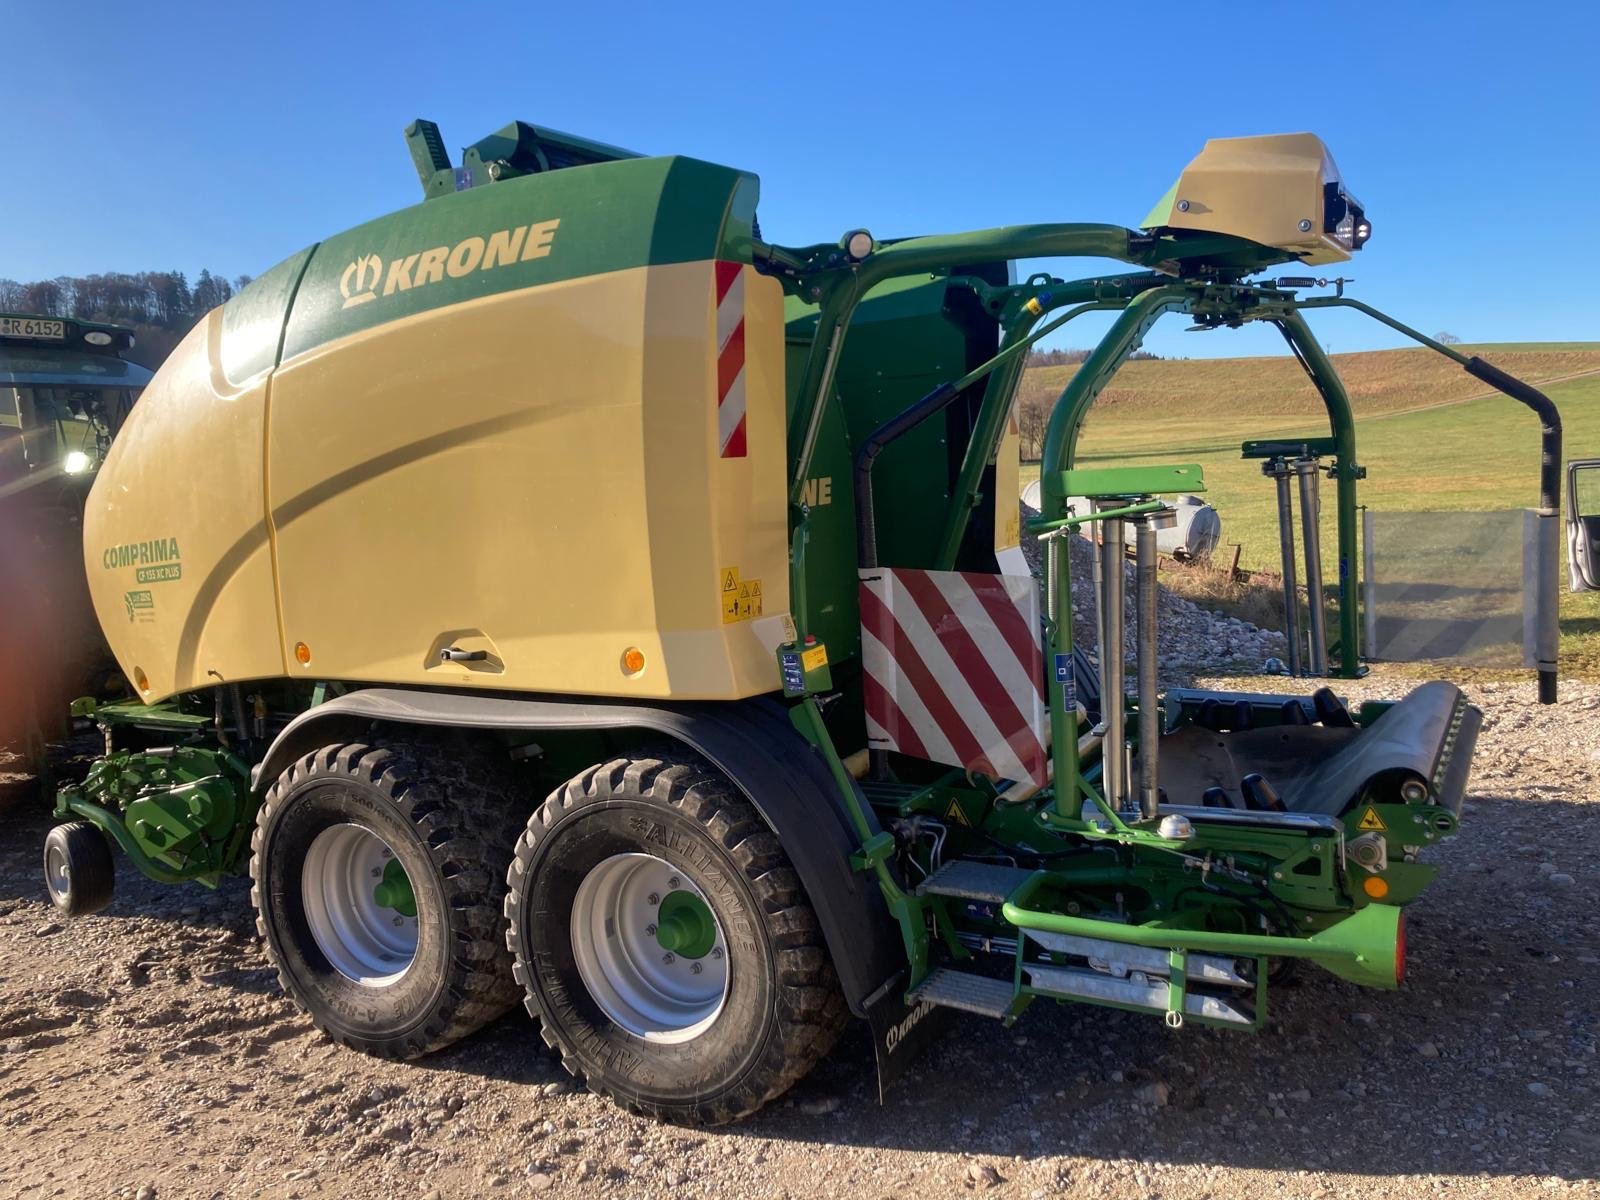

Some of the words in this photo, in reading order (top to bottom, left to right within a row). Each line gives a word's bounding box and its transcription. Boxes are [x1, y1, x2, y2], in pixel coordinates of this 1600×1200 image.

[383, 218, 560, 296] KRONE
[11, 320, 21, 334] R
[25, 321, 62, 336] 6152
[103, 537, 180, 569] COMPRIMA
[165, 566, 180, 578] PLUS
[643, 822, 757, 958] ALLIANCE
